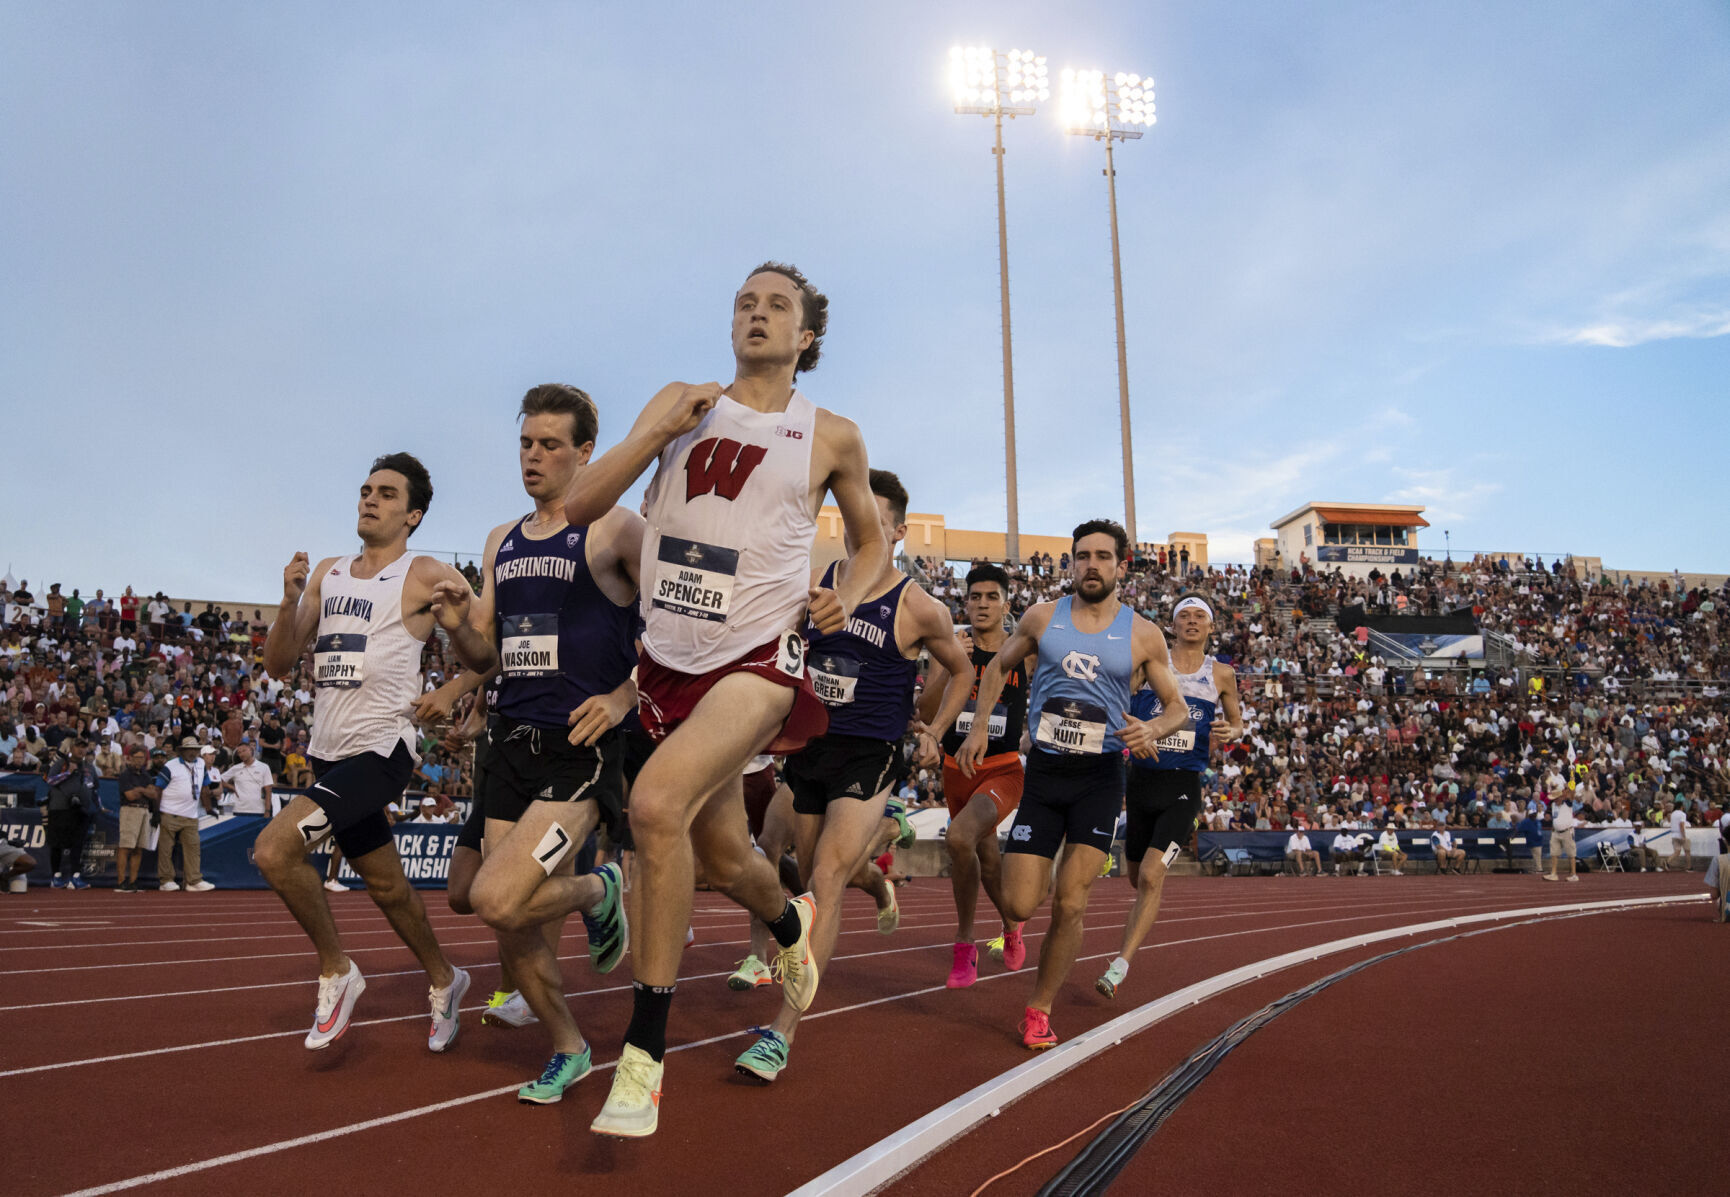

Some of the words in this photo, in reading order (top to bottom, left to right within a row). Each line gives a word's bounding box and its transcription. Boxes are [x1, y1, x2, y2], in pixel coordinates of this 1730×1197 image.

[684, 437, 768, 504] W
[1365, 548, 1382, 556] TRACK
[1390, 549, 1405, 557] FIELD
[495, 556, 576, 585] WASHINGTON
[679, 570, 703, 584] ADAM
[659, 579, 723, 609] SPENCER
[324, 596, 373, 622] VILLANOVA
[518, 640, 530, 649] JOE
[328, 655, 342, 663] LIAM
[505, 651, 551, 667] WASKOM
[785, 634, 802, 674] 9
[319, 665, 356, 678] MURPHY
[817, 674, 840, 686] NATHAN
[814, 682, 845, 700] GREEN
[1059, 719, 1082, 730] JESSE
[1053, 728, 1086, 746] HUNT
[1156, 737, 1188, 748] BASTEN
[426, 835, 440, 857] &
[539, 828, 569, 863] 7
